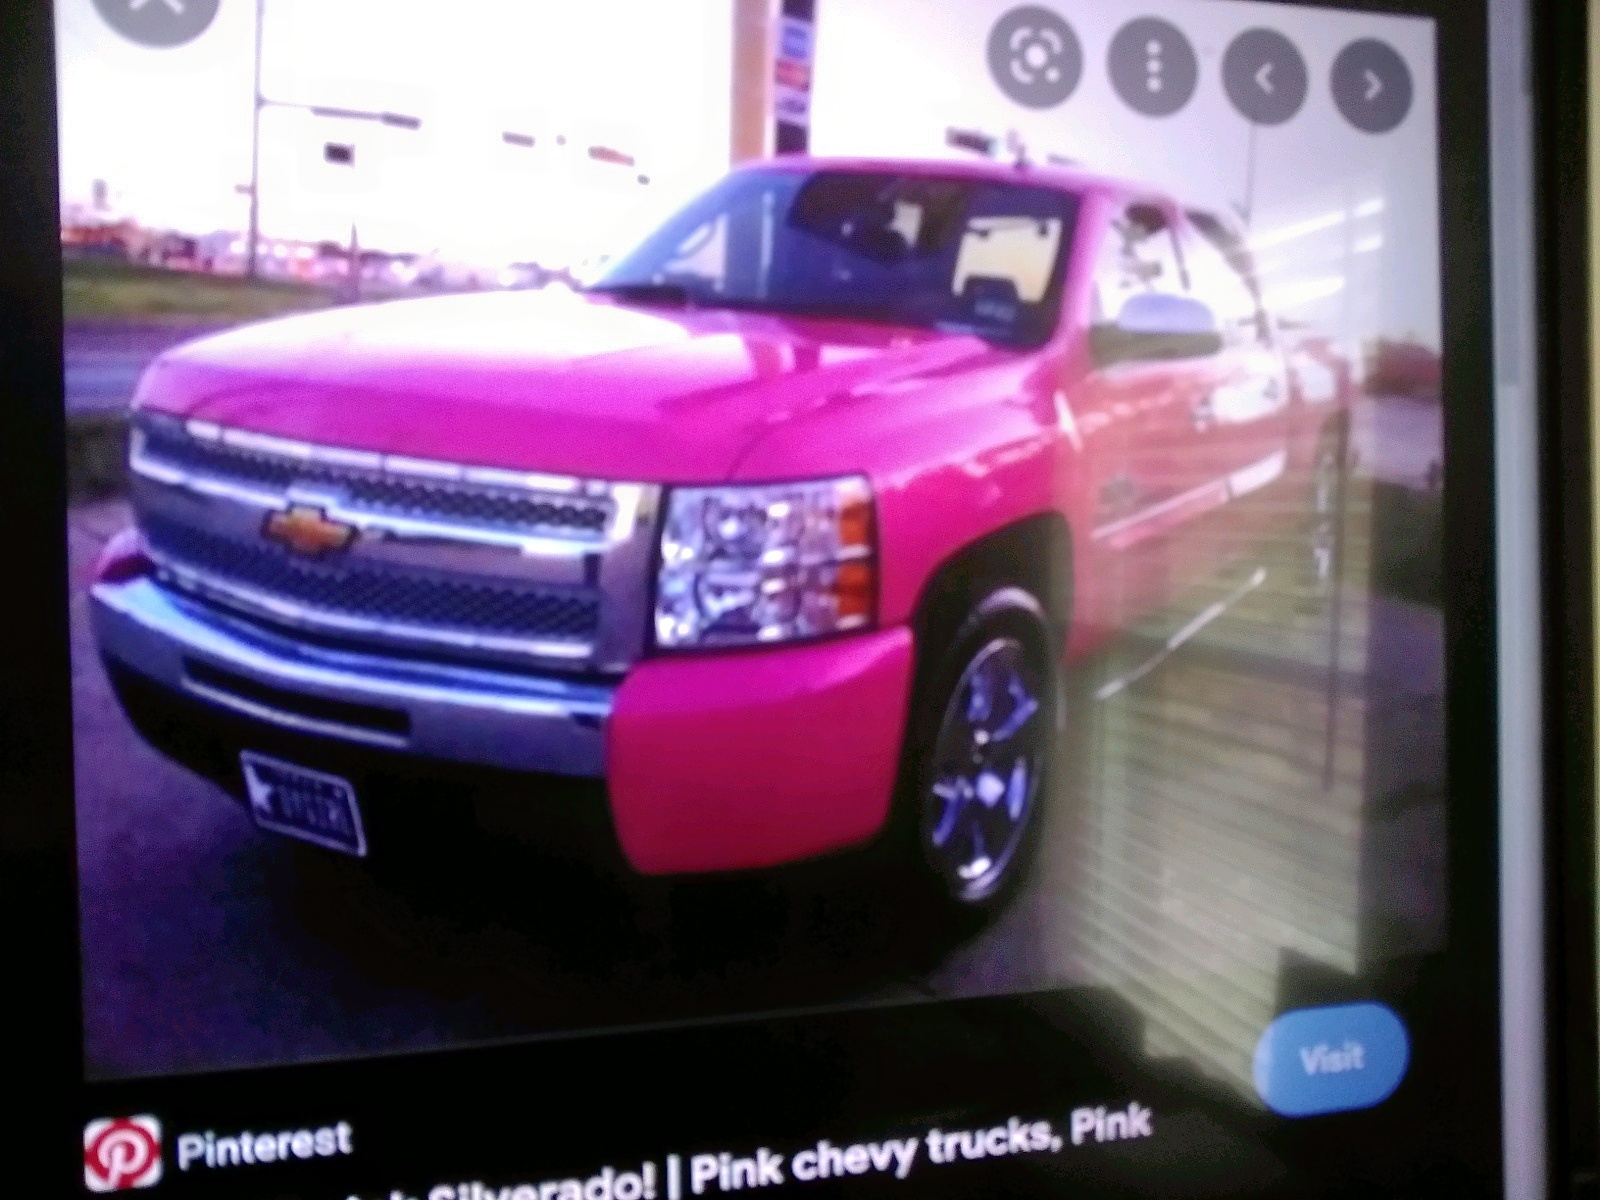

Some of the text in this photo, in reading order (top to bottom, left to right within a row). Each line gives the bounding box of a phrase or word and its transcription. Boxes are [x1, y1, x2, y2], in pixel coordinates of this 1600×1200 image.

[1301, 1041, 1365, 1075] Visit
[177, 1120, 352, 1171] Pinterest
[690, 1147, 785, 1195] Pink
[791, 1137, 920, 1180] chevy
[924, 1115, 1063, 1165] trucks,
[1070, 1101, 1153, 1145] Pink
